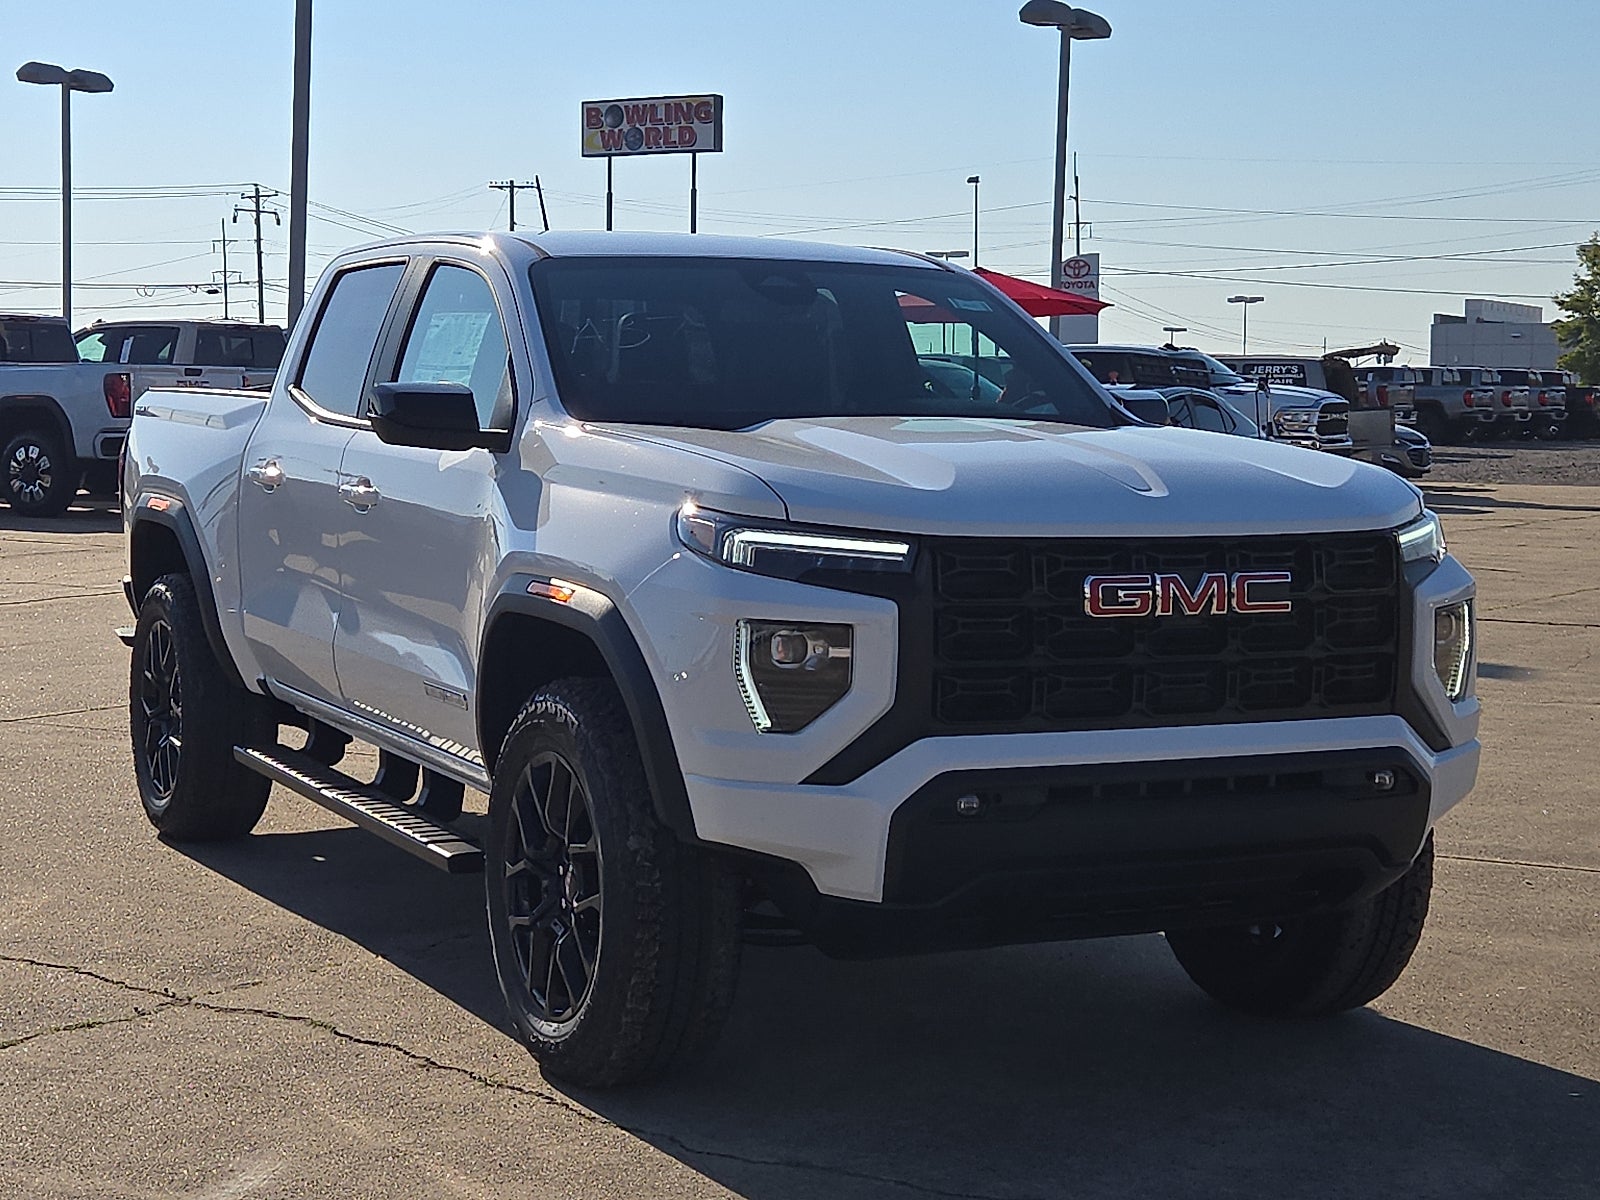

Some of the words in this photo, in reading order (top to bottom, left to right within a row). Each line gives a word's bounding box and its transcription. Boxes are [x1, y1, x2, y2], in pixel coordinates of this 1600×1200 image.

[586, 101, 713, 128] BOWLING
[600, 126, 697, 150] WORLD
[1250, 365, 1299, 374] JERRY'S
[1084, 571, 1292, 617] GMC
